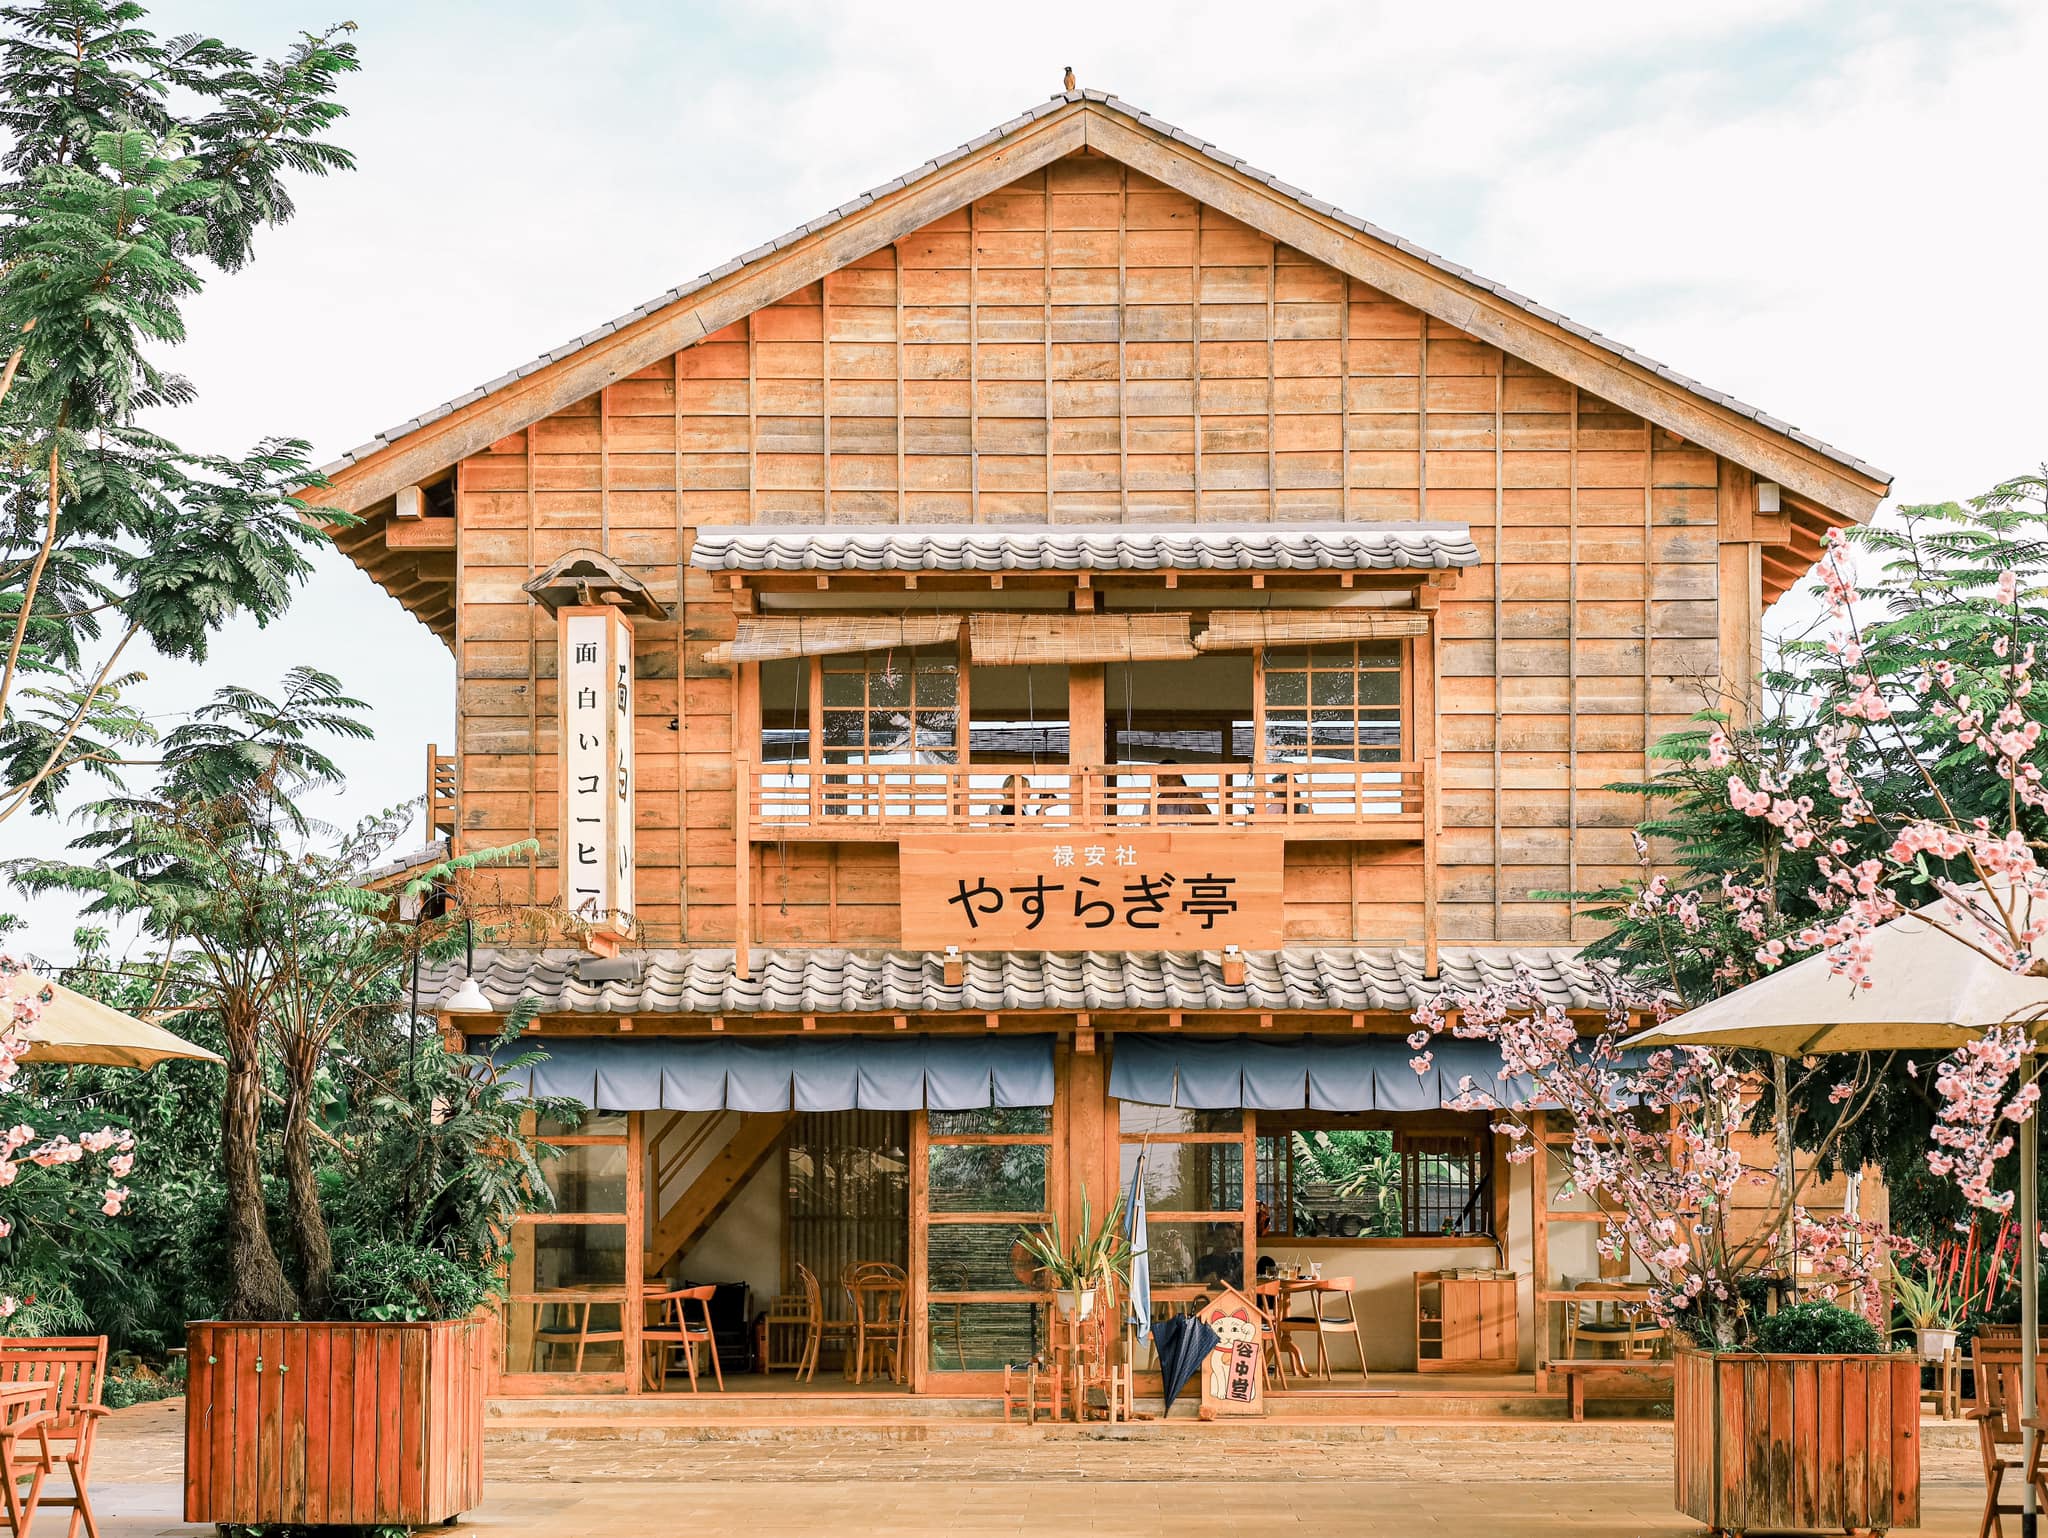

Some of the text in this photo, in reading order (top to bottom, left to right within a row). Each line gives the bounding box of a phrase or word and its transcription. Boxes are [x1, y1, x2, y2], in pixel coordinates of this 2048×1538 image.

[575, 641, 601, 895] 面白いコーヒー
[1052, 845, 1138, 867] 禄安社
[947, 871, 1238, 936] やすらぎ亭
[1231, 1342, 1253, 1400] 谷中堂
